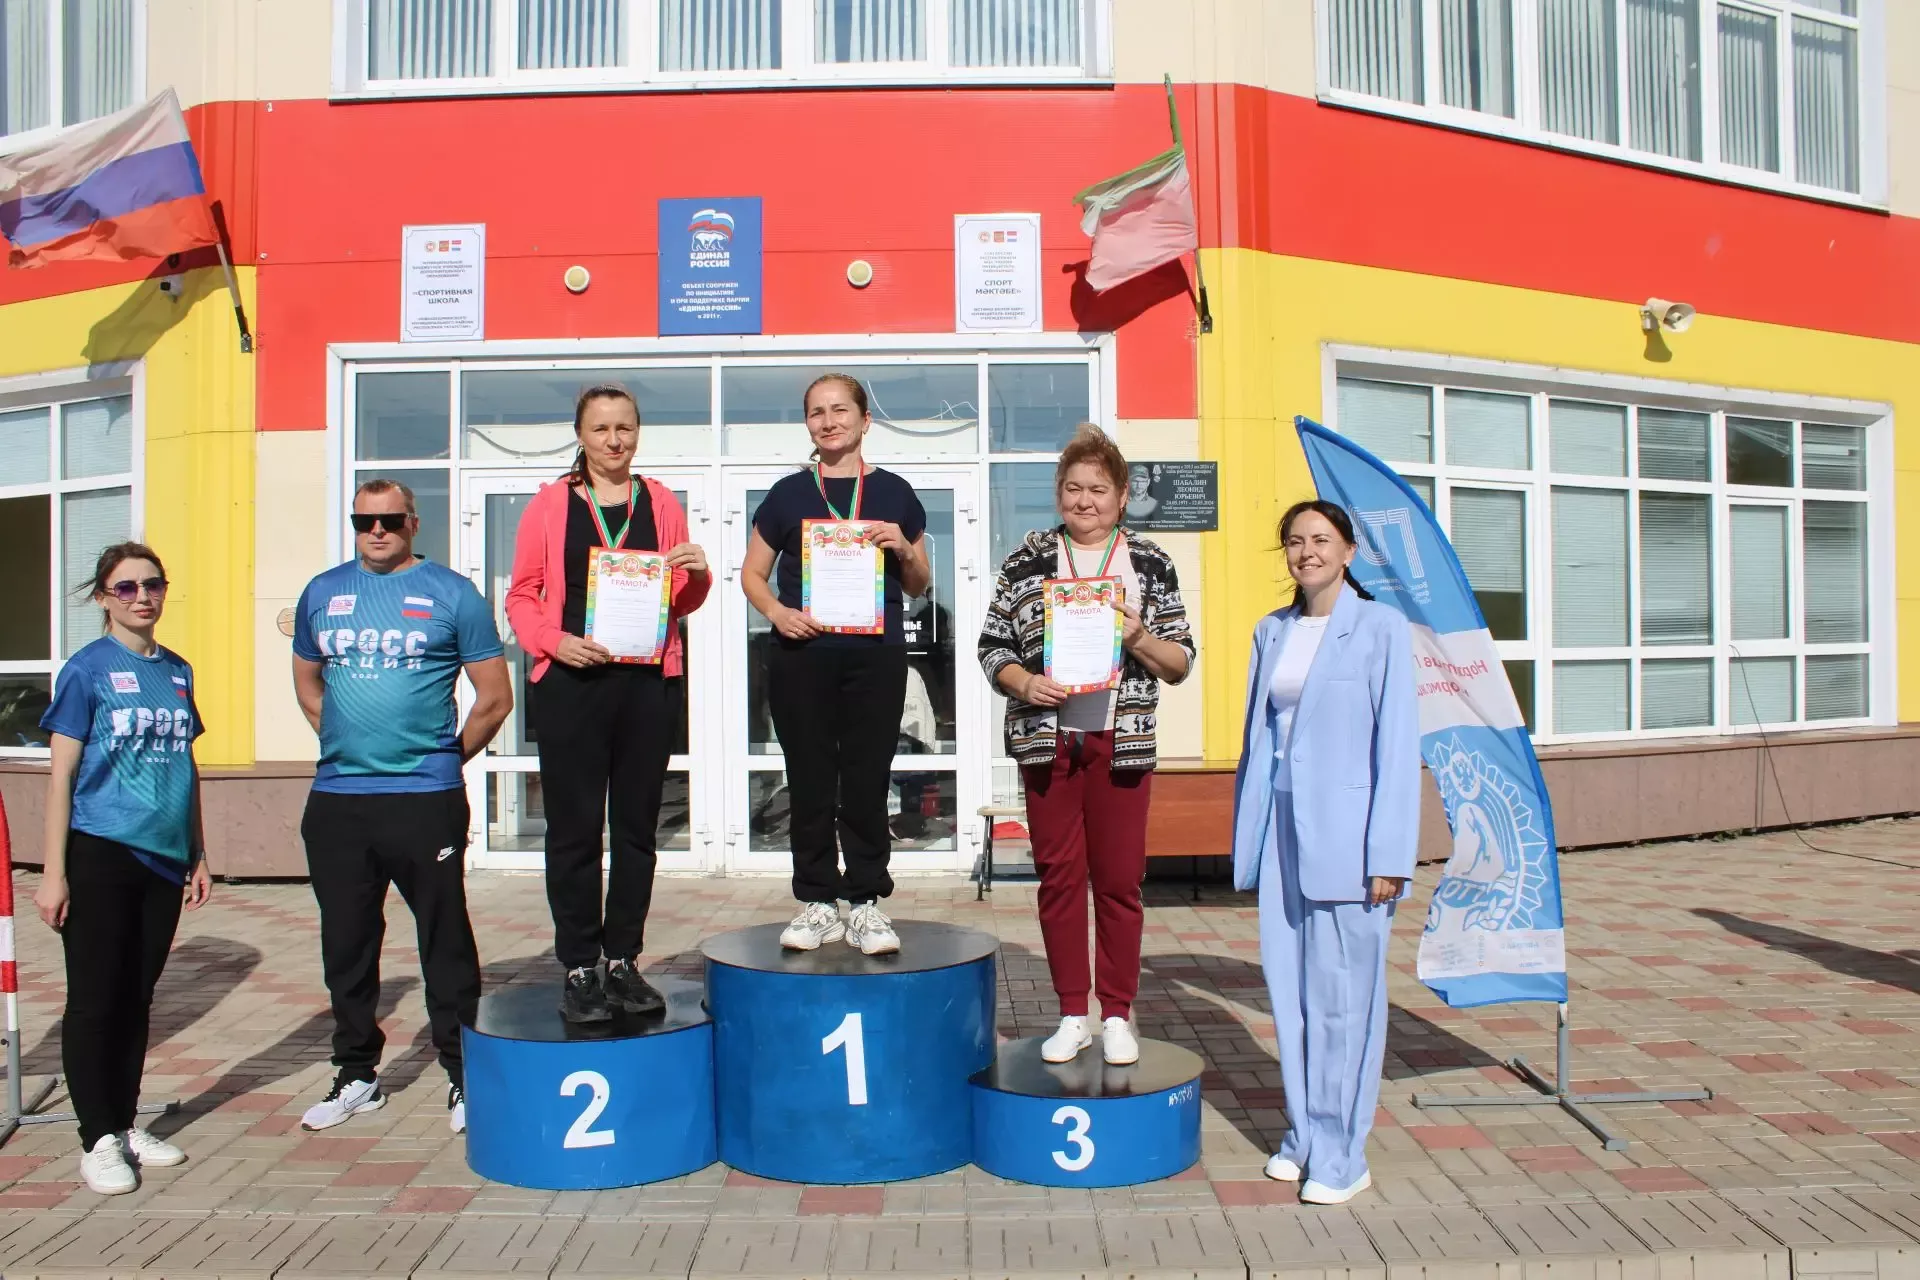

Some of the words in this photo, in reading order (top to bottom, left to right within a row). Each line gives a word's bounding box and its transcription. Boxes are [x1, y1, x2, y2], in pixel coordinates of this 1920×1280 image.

[690, 252, 730, 260] ЕДИНАЯ
[690, 260, 730, 268] РОССИЯ
[428, 297, 460, 305] ШКОЛА
[824, 549, 862, 557] ГРАМОТА
[611, 578, 648, 588] ГРАМОТА
[1066, 607, 1102, 616] ГРАМОТА
[318, 629, 427, 656] КРОСС
[110, 739, 187, 752] НАЦИ
[821, 1012, 868, 1105] 1
[560, 1070, 616, 1150] 2
[1050, 1105, 1095, 1172] 3
